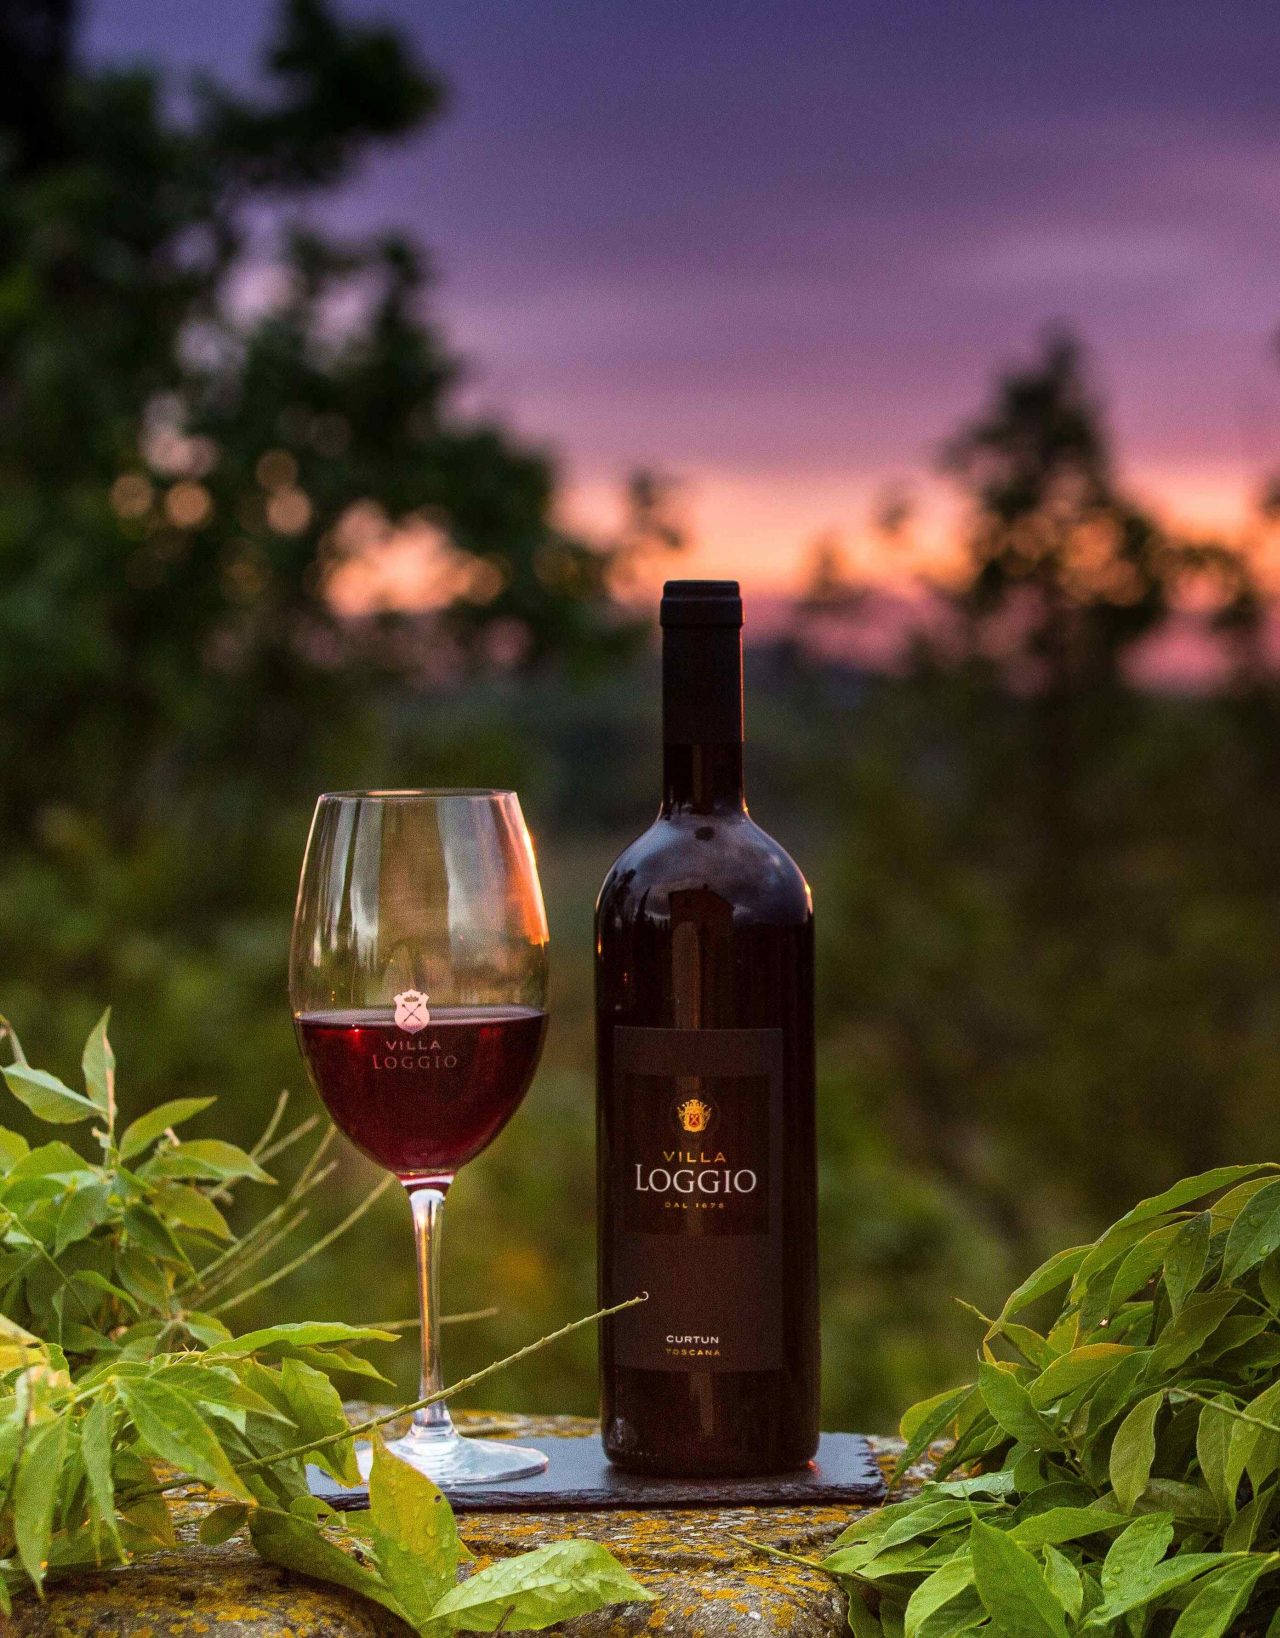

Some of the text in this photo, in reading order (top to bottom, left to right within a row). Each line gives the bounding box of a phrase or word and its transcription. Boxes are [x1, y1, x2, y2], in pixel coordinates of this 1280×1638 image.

[386, 1040, 441, 1050] VILLA
[372, 1054, 458, 1070] LOGGIO
[663, 1151, 726, 1163] VILLA
[634, 1163, 757, 1193] LOGGIO
[664, 1201, 688, 1209] DAL
[666, 1334, 719, 1344] CURTUN
[665, 1348, 720, 1356] TOSCANA
